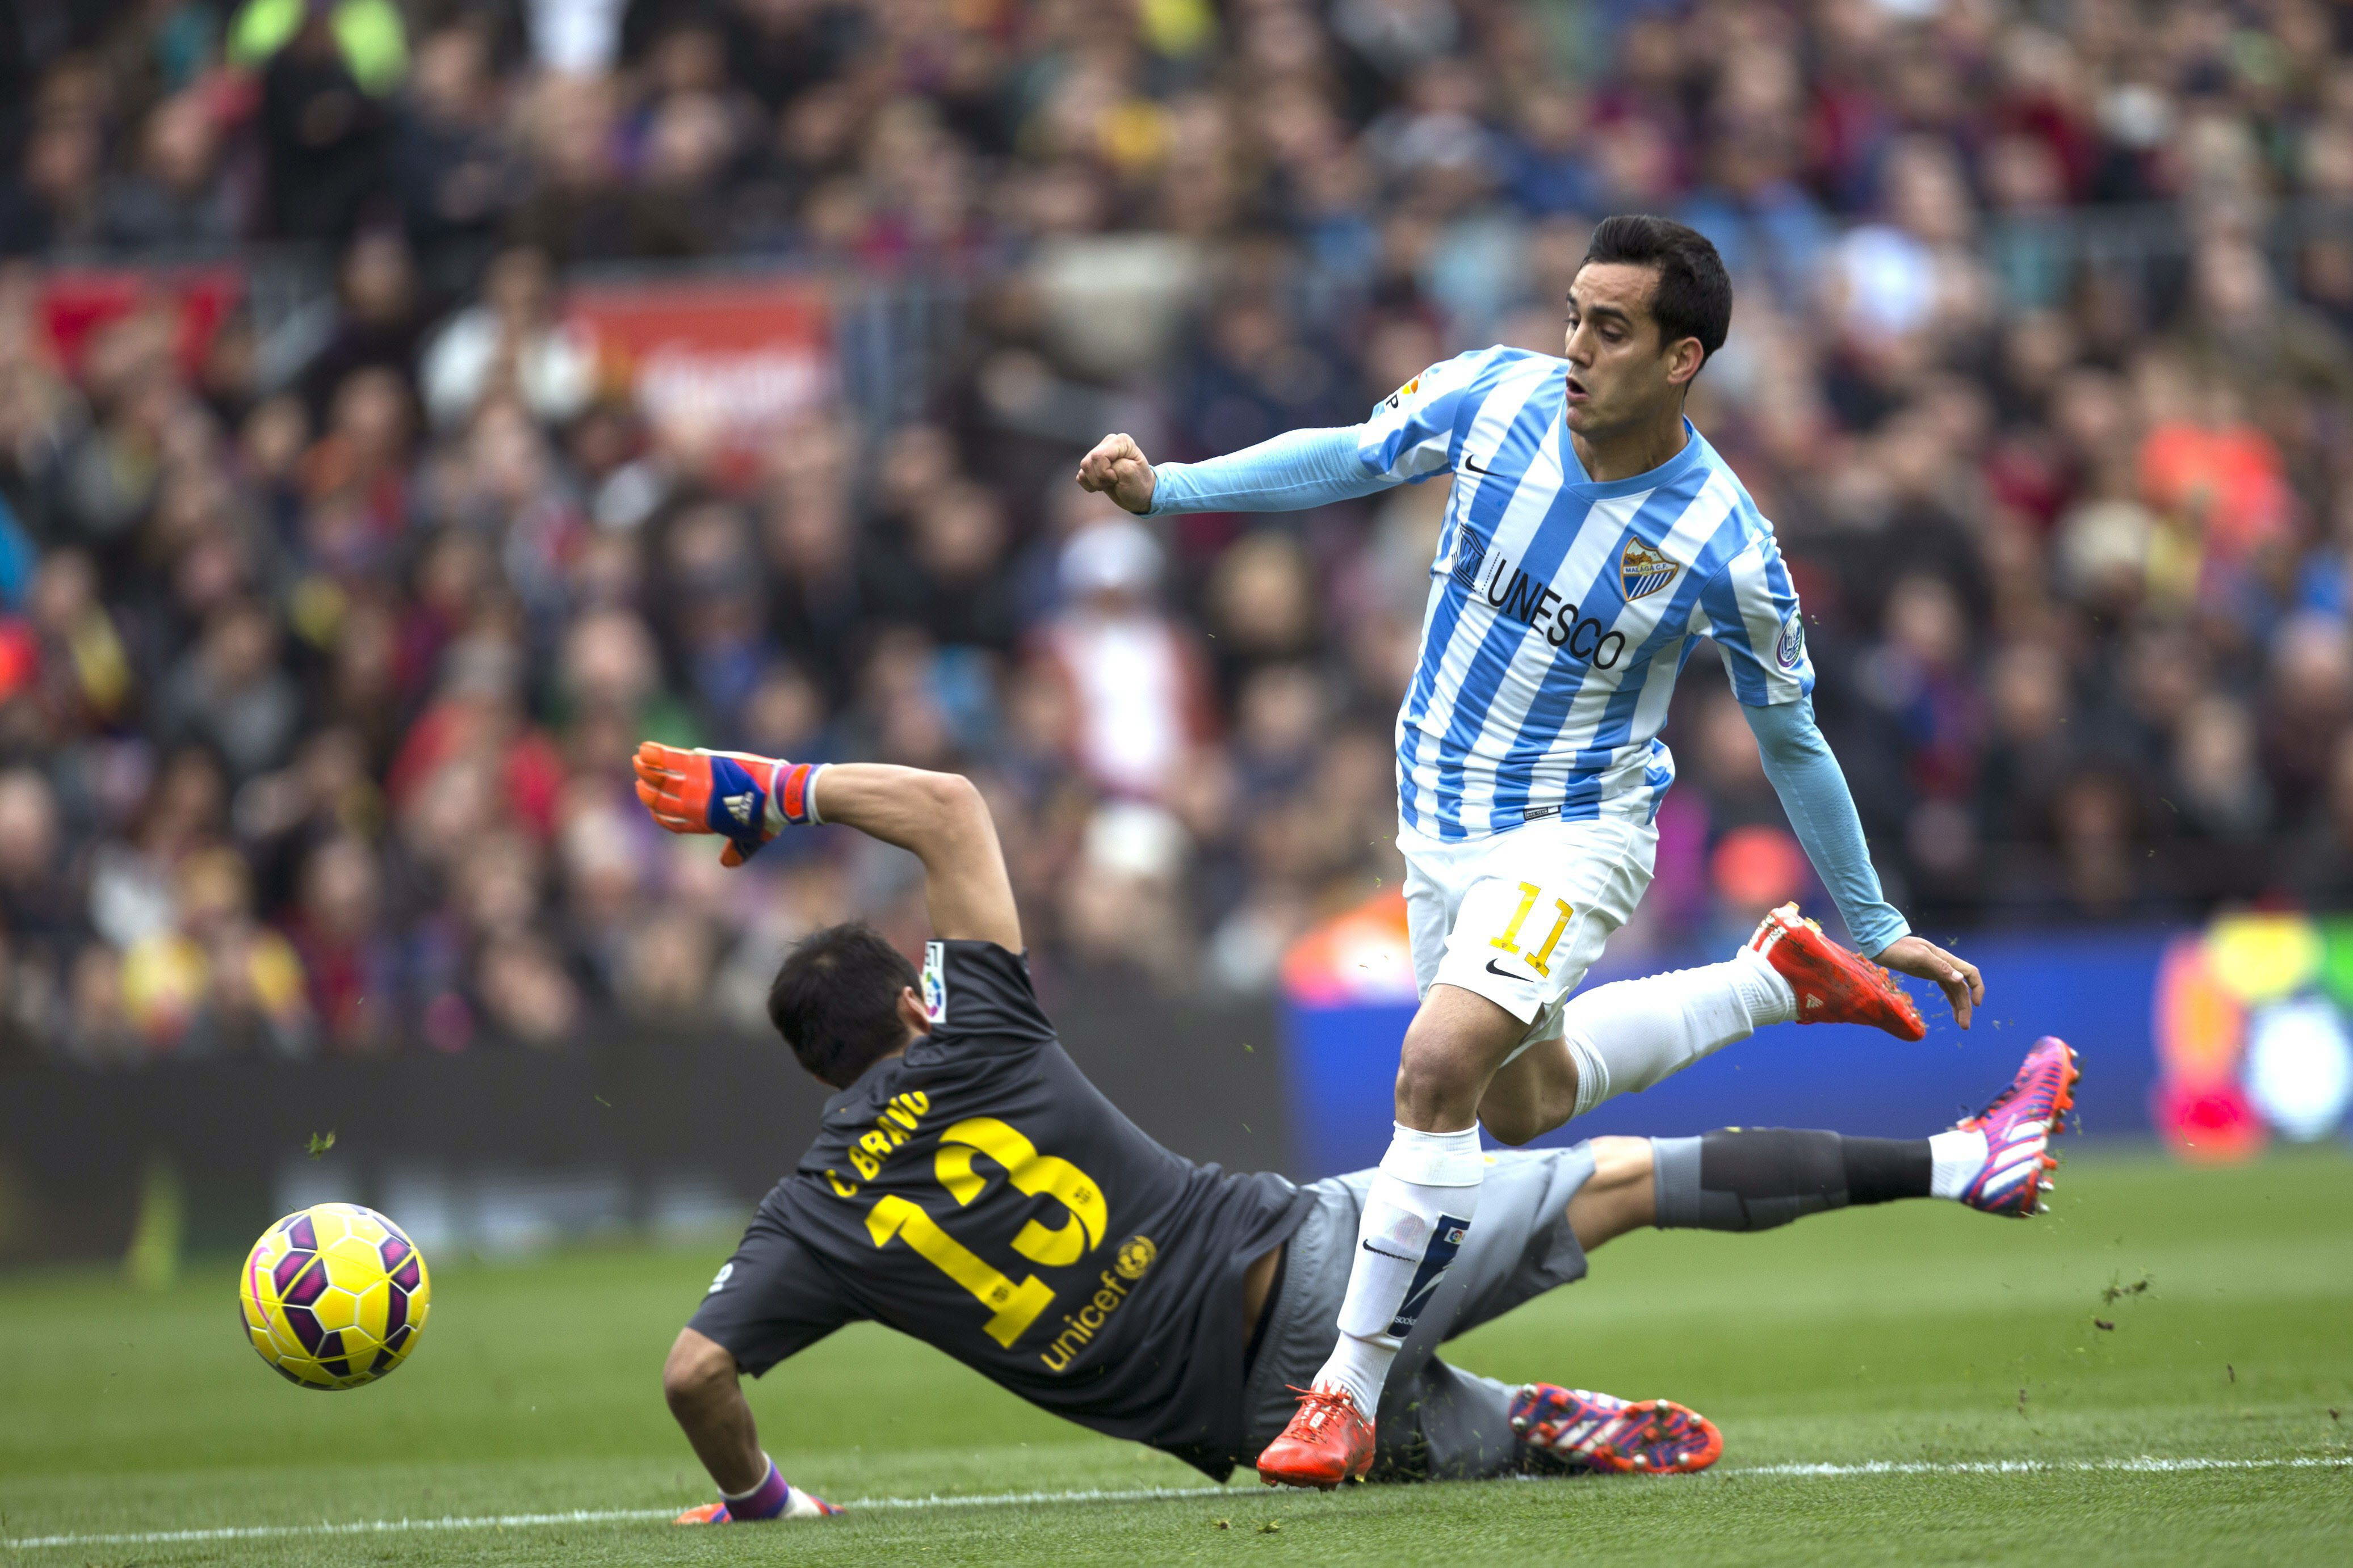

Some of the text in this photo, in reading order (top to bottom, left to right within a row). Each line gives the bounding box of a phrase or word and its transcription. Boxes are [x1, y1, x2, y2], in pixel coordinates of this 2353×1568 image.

[1488, 558, 1625, 670] UNESCO
[1489, 881, 1574, 978] 11
[864, 1116, 1108, 1350] 13
[1041, 1269, 1128, 1372] unicef
